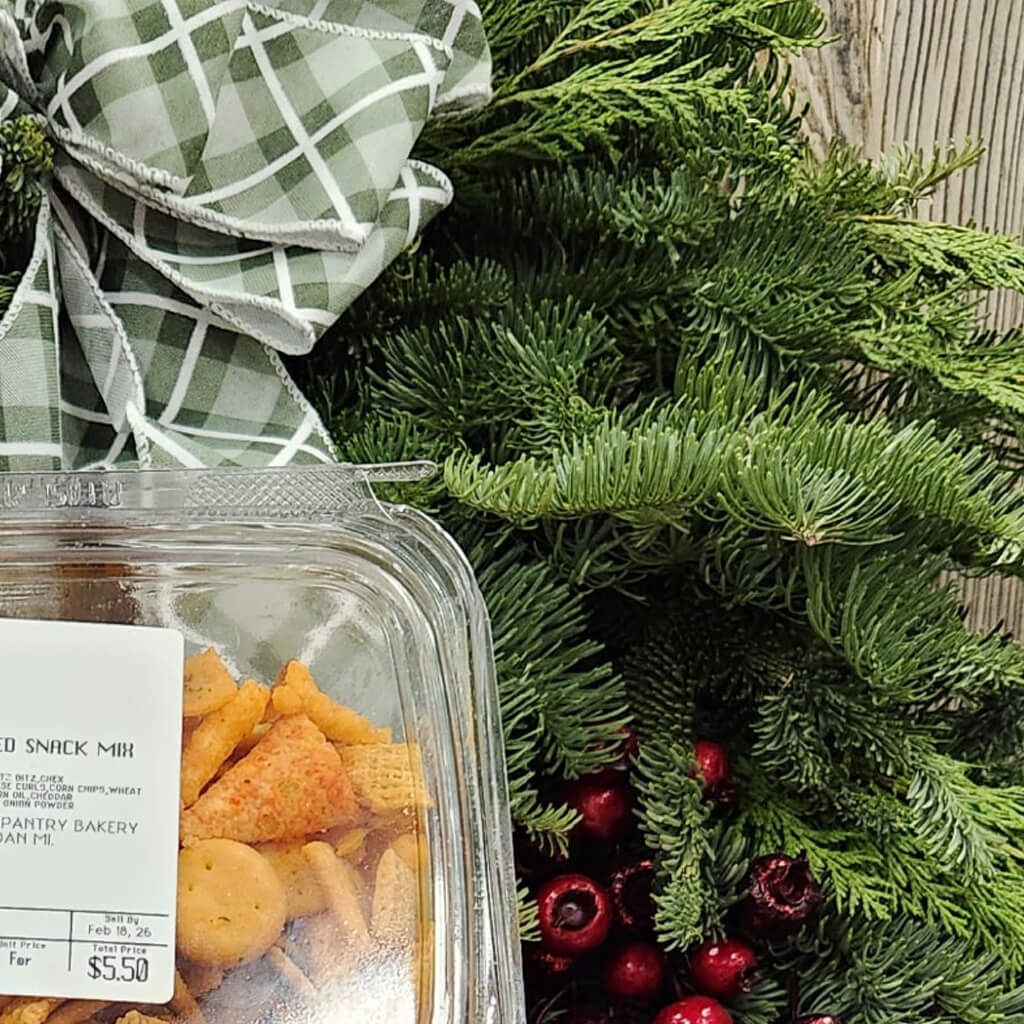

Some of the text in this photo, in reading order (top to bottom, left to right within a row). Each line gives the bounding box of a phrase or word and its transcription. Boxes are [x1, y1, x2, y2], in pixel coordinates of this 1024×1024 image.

[25, 738, 88, 756] SNACK
[97, 742, 134, 758] MIX
[1, 816, 68, 832] PANTRY
[74, 819, 138, 835] BAKERY
[105, 914, 124, 923] Sell
[88, 924, 152, 938] Feb 18, 26
[20, 941, 46, 950] Price
[93, 944, 147, 955] Total Price
[9, 950, 32, 967] For
[87, 954, 149, 983] $5.50
